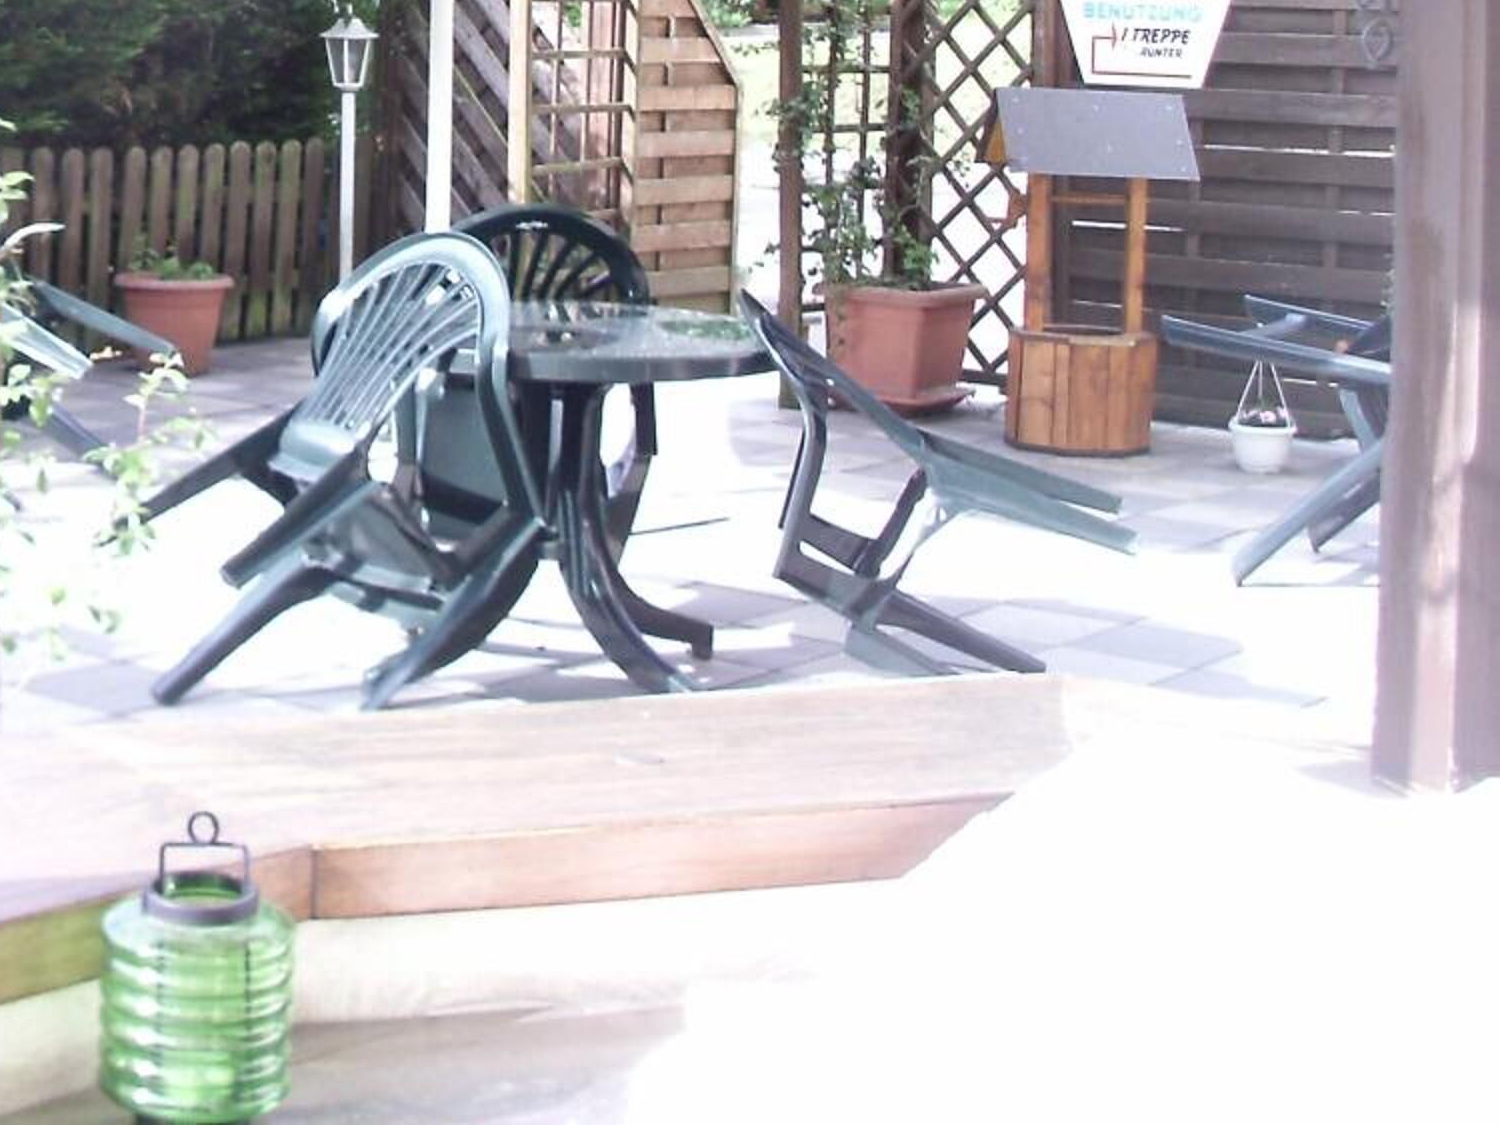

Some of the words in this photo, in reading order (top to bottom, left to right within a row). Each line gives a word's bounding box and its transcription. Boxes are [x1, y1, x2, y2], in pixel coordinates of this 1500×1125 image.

[1083, 1, 1204, 22] BENUTZUNG
[1132, 28, 1191, 45] TREPPE
[1140, 47, 1183, 59] RUNTER
